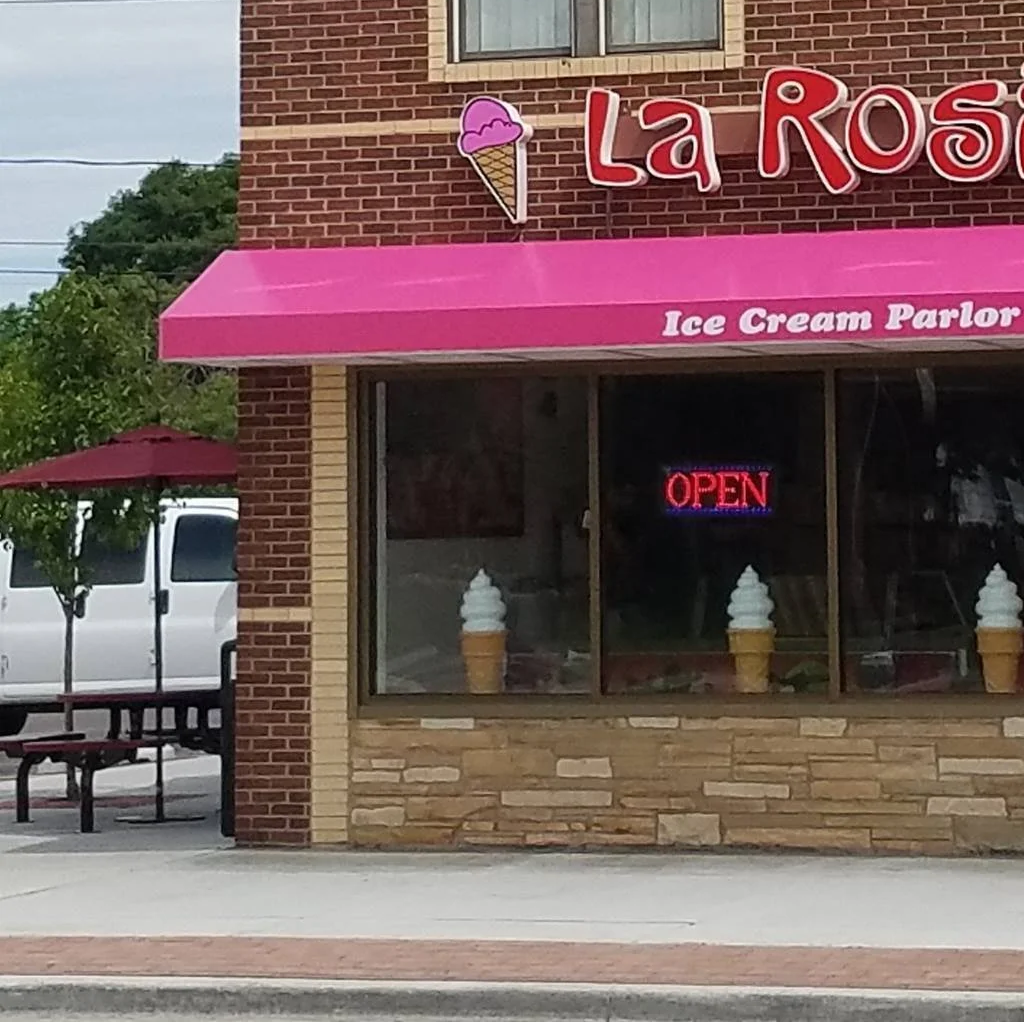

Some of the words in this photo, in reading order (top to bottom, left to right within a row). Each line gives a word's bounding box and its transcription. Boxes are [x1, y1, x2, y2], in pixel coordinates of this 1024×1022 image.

[584, 86, 721, 193] La
[662, 310, 725, 336] Ice
[739, 307, 873, 334] Cream
[885, 301, 1021, 330] Parlor
[666, 471, 770, 509] OPEN
